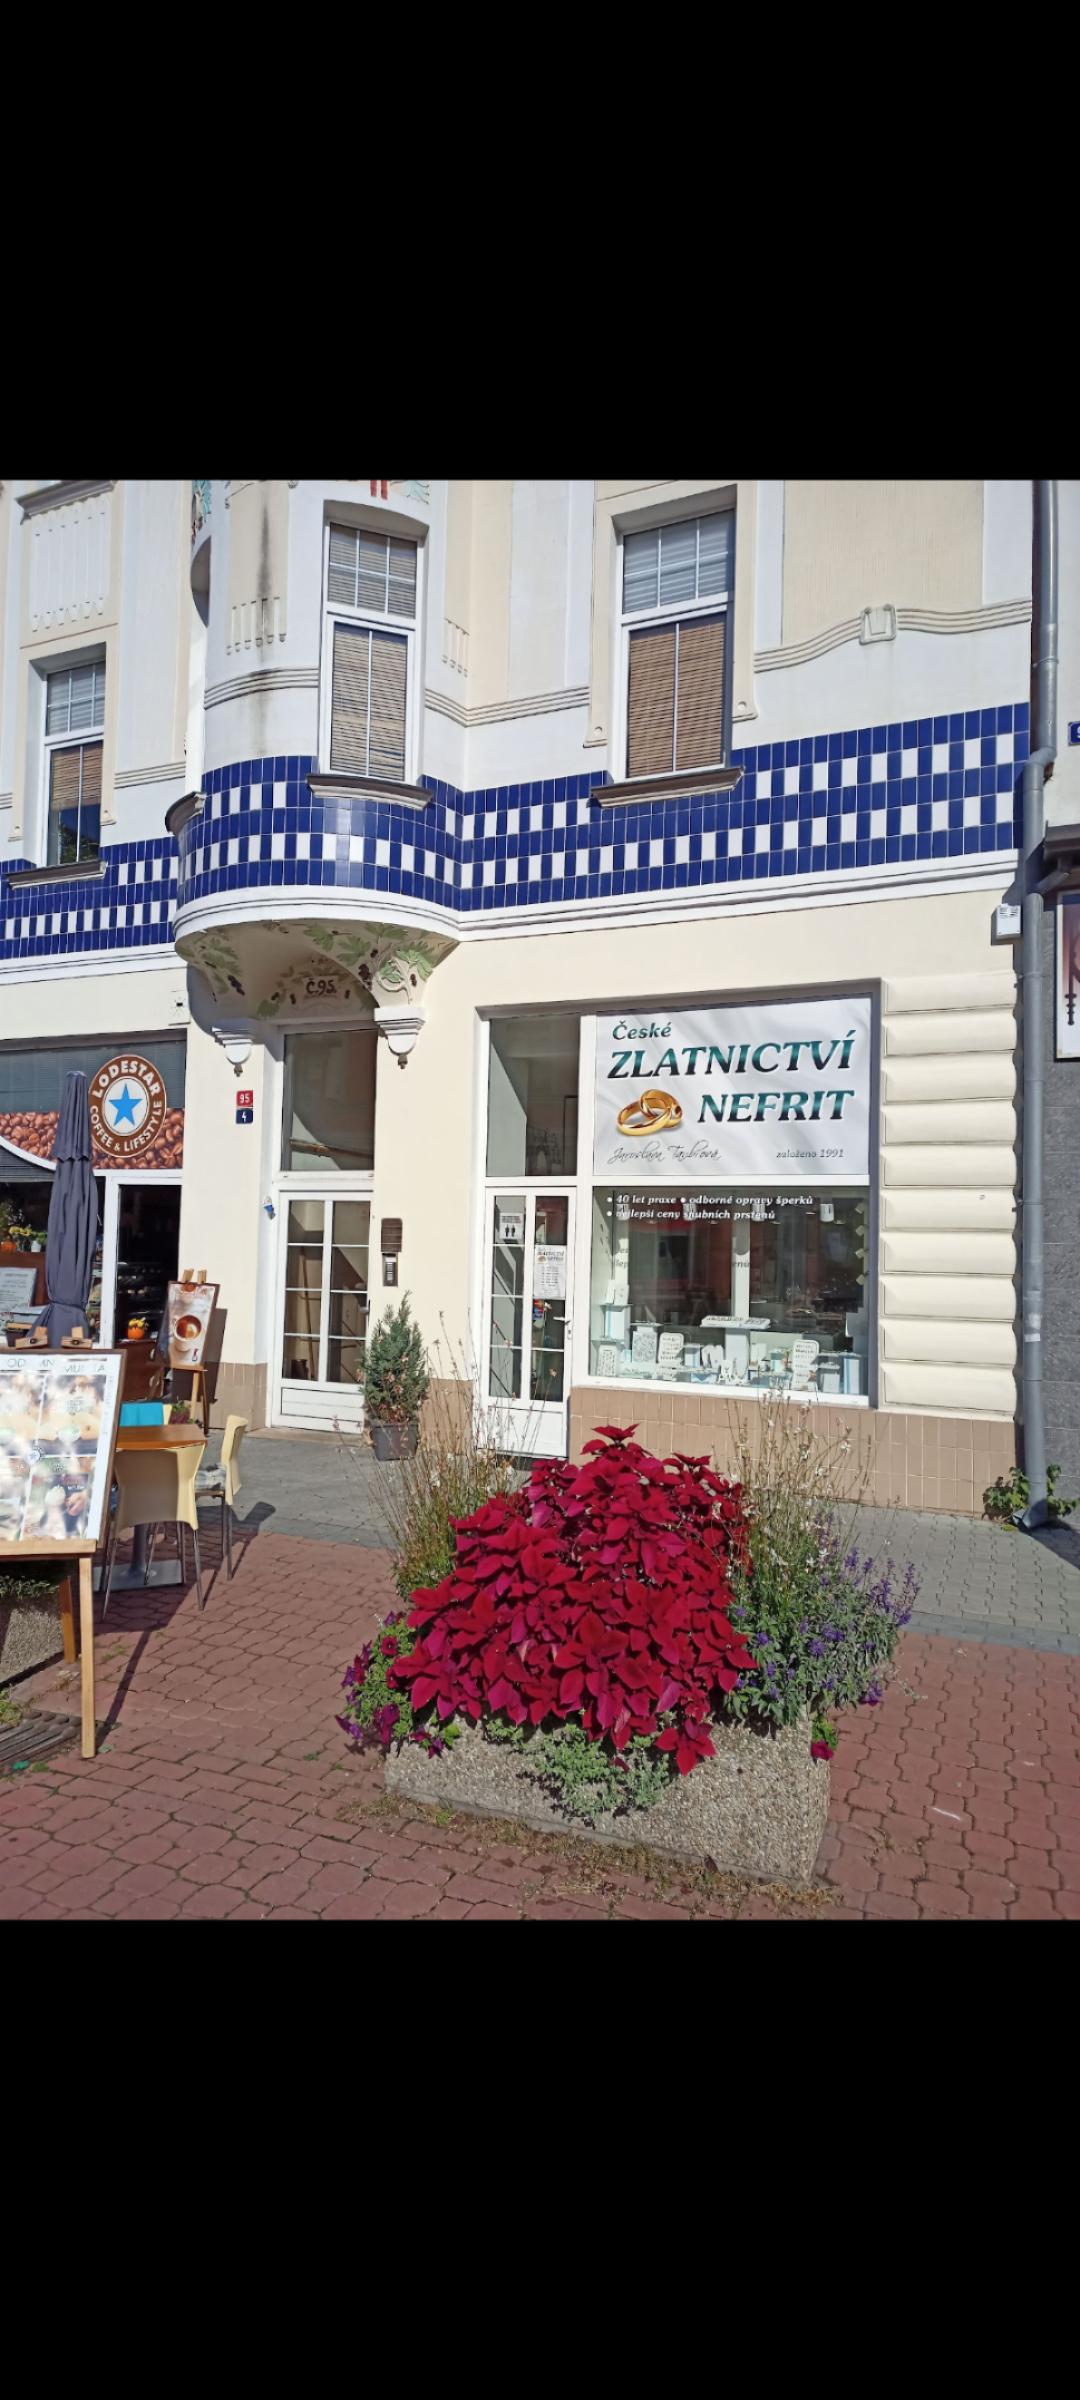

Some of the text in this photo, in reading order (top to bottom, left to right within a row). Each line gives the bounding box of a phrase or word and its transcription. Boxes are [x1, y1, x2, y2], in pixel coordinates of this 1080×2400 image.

[612, 1020, 672, 1041] České
[607, 1029, 856, 1079] ZLATNICTVÍ
[92, 1060, 161, 1099] LODESTAR
[239, 1093, 250, 1104] 95
[697, 1089, 855, 1124] NEFRIT
[90, 1105, 114, 1148] COFFEE
[123, 1100, 162, 1152] LIFESTYLE
[819, 1148, 845, 1158] 1991
[616, 1194, 814, 1207] 40 let praxe odborné opravy šperků
[656, 1210, 681, 1220] ceny
